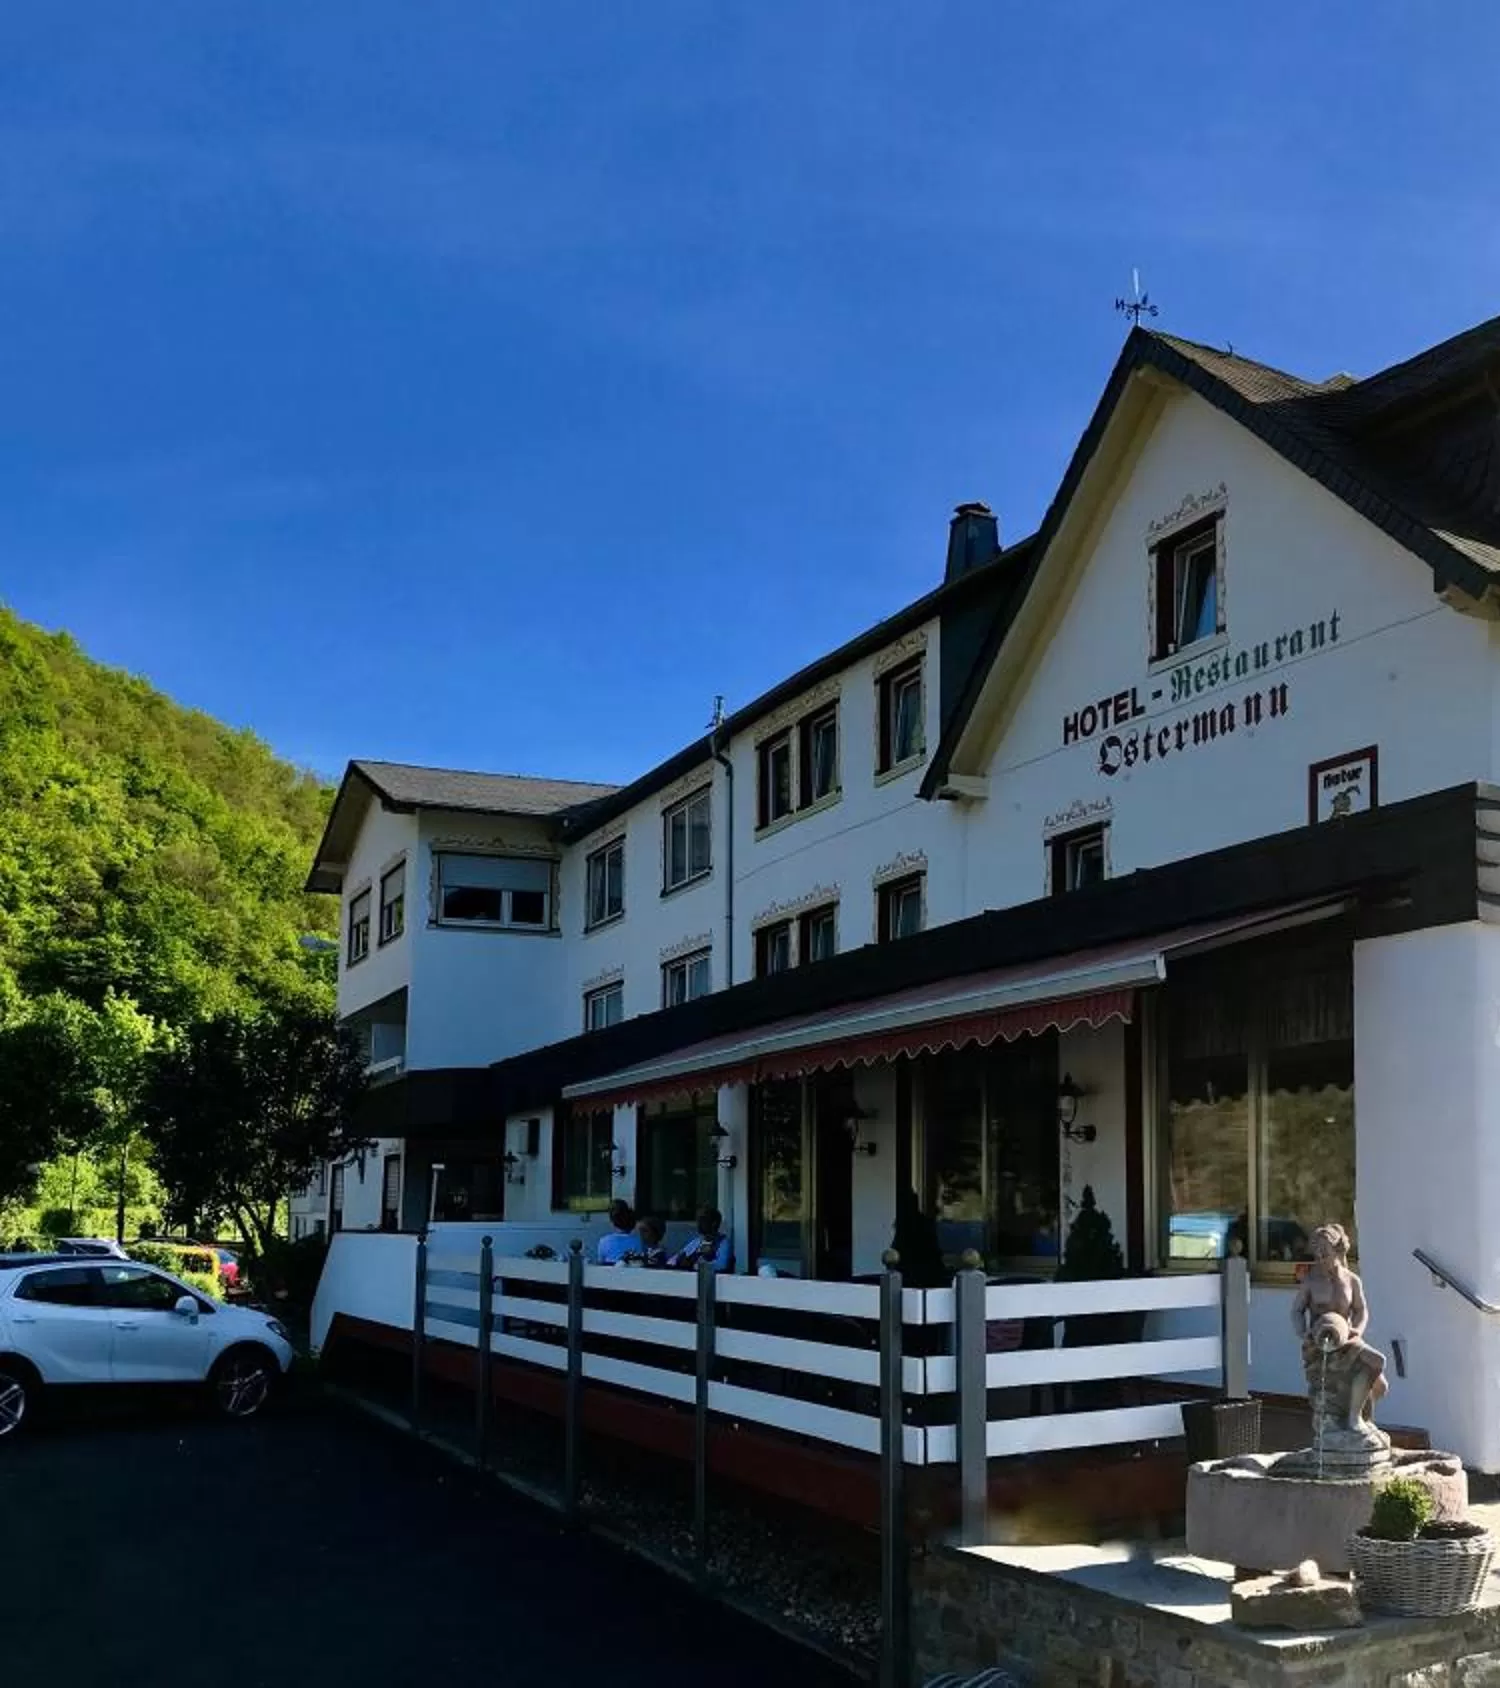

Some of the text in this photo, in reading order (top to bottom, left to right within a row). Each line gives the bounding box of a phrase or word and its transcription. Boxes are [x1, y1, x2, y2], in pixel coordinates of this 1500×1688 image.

[1063, 688, 1145, 745] HOTEL
[1170, 609, 1342, 702] Restaurant
[1098, 682, 1289, 776] Ostermann
